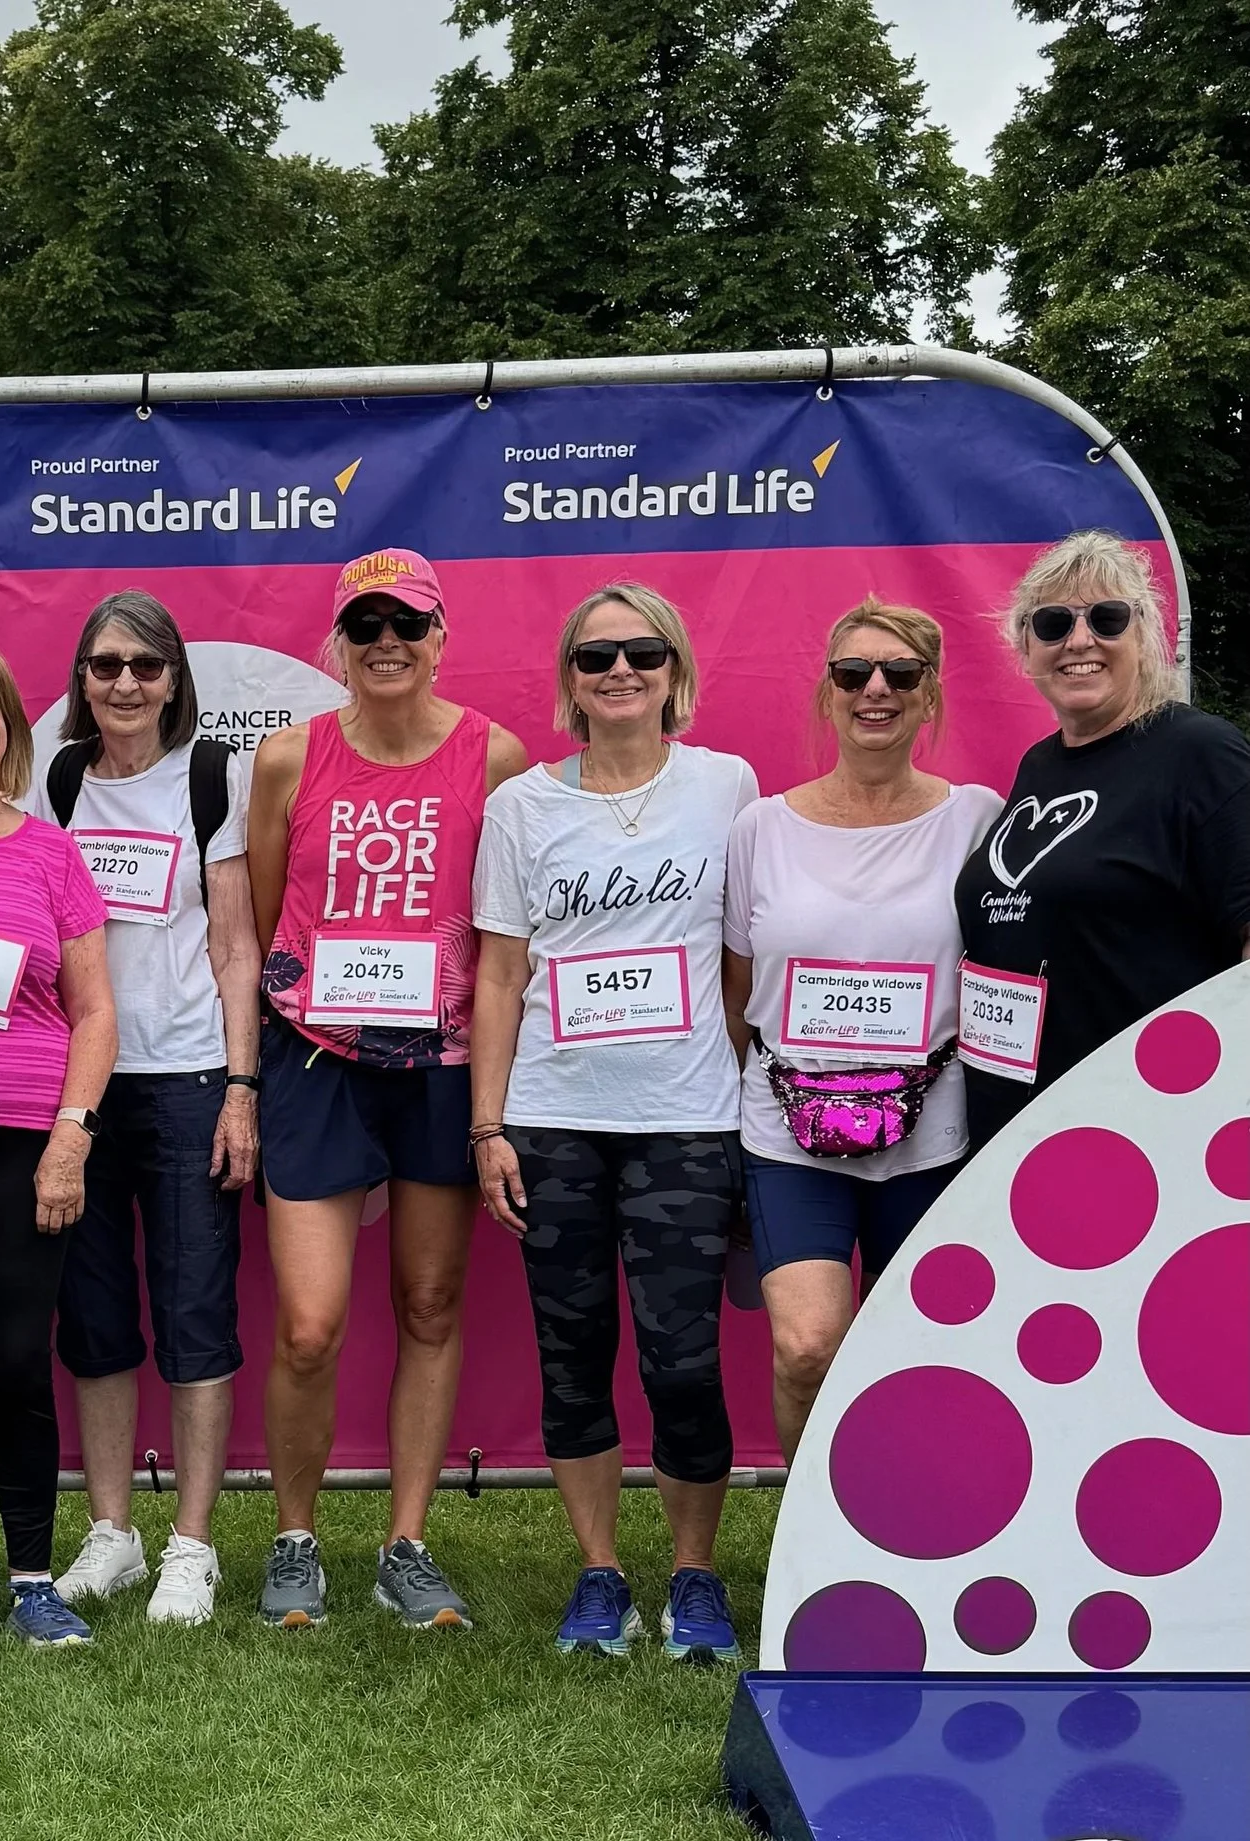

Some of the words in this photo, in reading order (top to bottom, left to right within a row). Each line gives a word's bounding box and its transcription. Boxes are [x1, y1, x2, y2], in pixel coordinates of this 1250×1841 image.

[505, 446, 559, 461] Proud
[565, 443, 636, 459] Partner
[32, 459, 84, 474] Proud
[91, 457, 160, 473] Partner
[504, 470, 715, 523] Standard
[727, 469, 813, 515] Life
[32, 489, 239, 534] Standard
[251, 486, 336, 532] Life
[344, 554, 417, 591] PORTUGAL
[199, 710, 292, 729] CANCER
[330, 797, 442, 831] RACE
[129, 845, 169, 856] Widows
[328, 830, 437, 875] FOR
[91, 858, 138, 874] 21270
[323, 873, 436, 919] LIFE
[546, 871, 596, 921] Oh
[599, 866, 643, 910] là
[646, 858, 708, 904] là!
[981, 890, 1032, 910] Cambridge
[989, 907, 1025, 923] Widows
[360, 946, 391, 958] Vicky
[343, 963, 404, 979] 20475
[587, 968, 652, 994] 5457
[798, 975, 869, 990] Cambridge
[873, 979, 922, 990] Widows
[823, 995, 891, 1013] 20435
[1001, 988, 1037, 1004] Widows
[973, 1000, 1013, 1026] 20334
